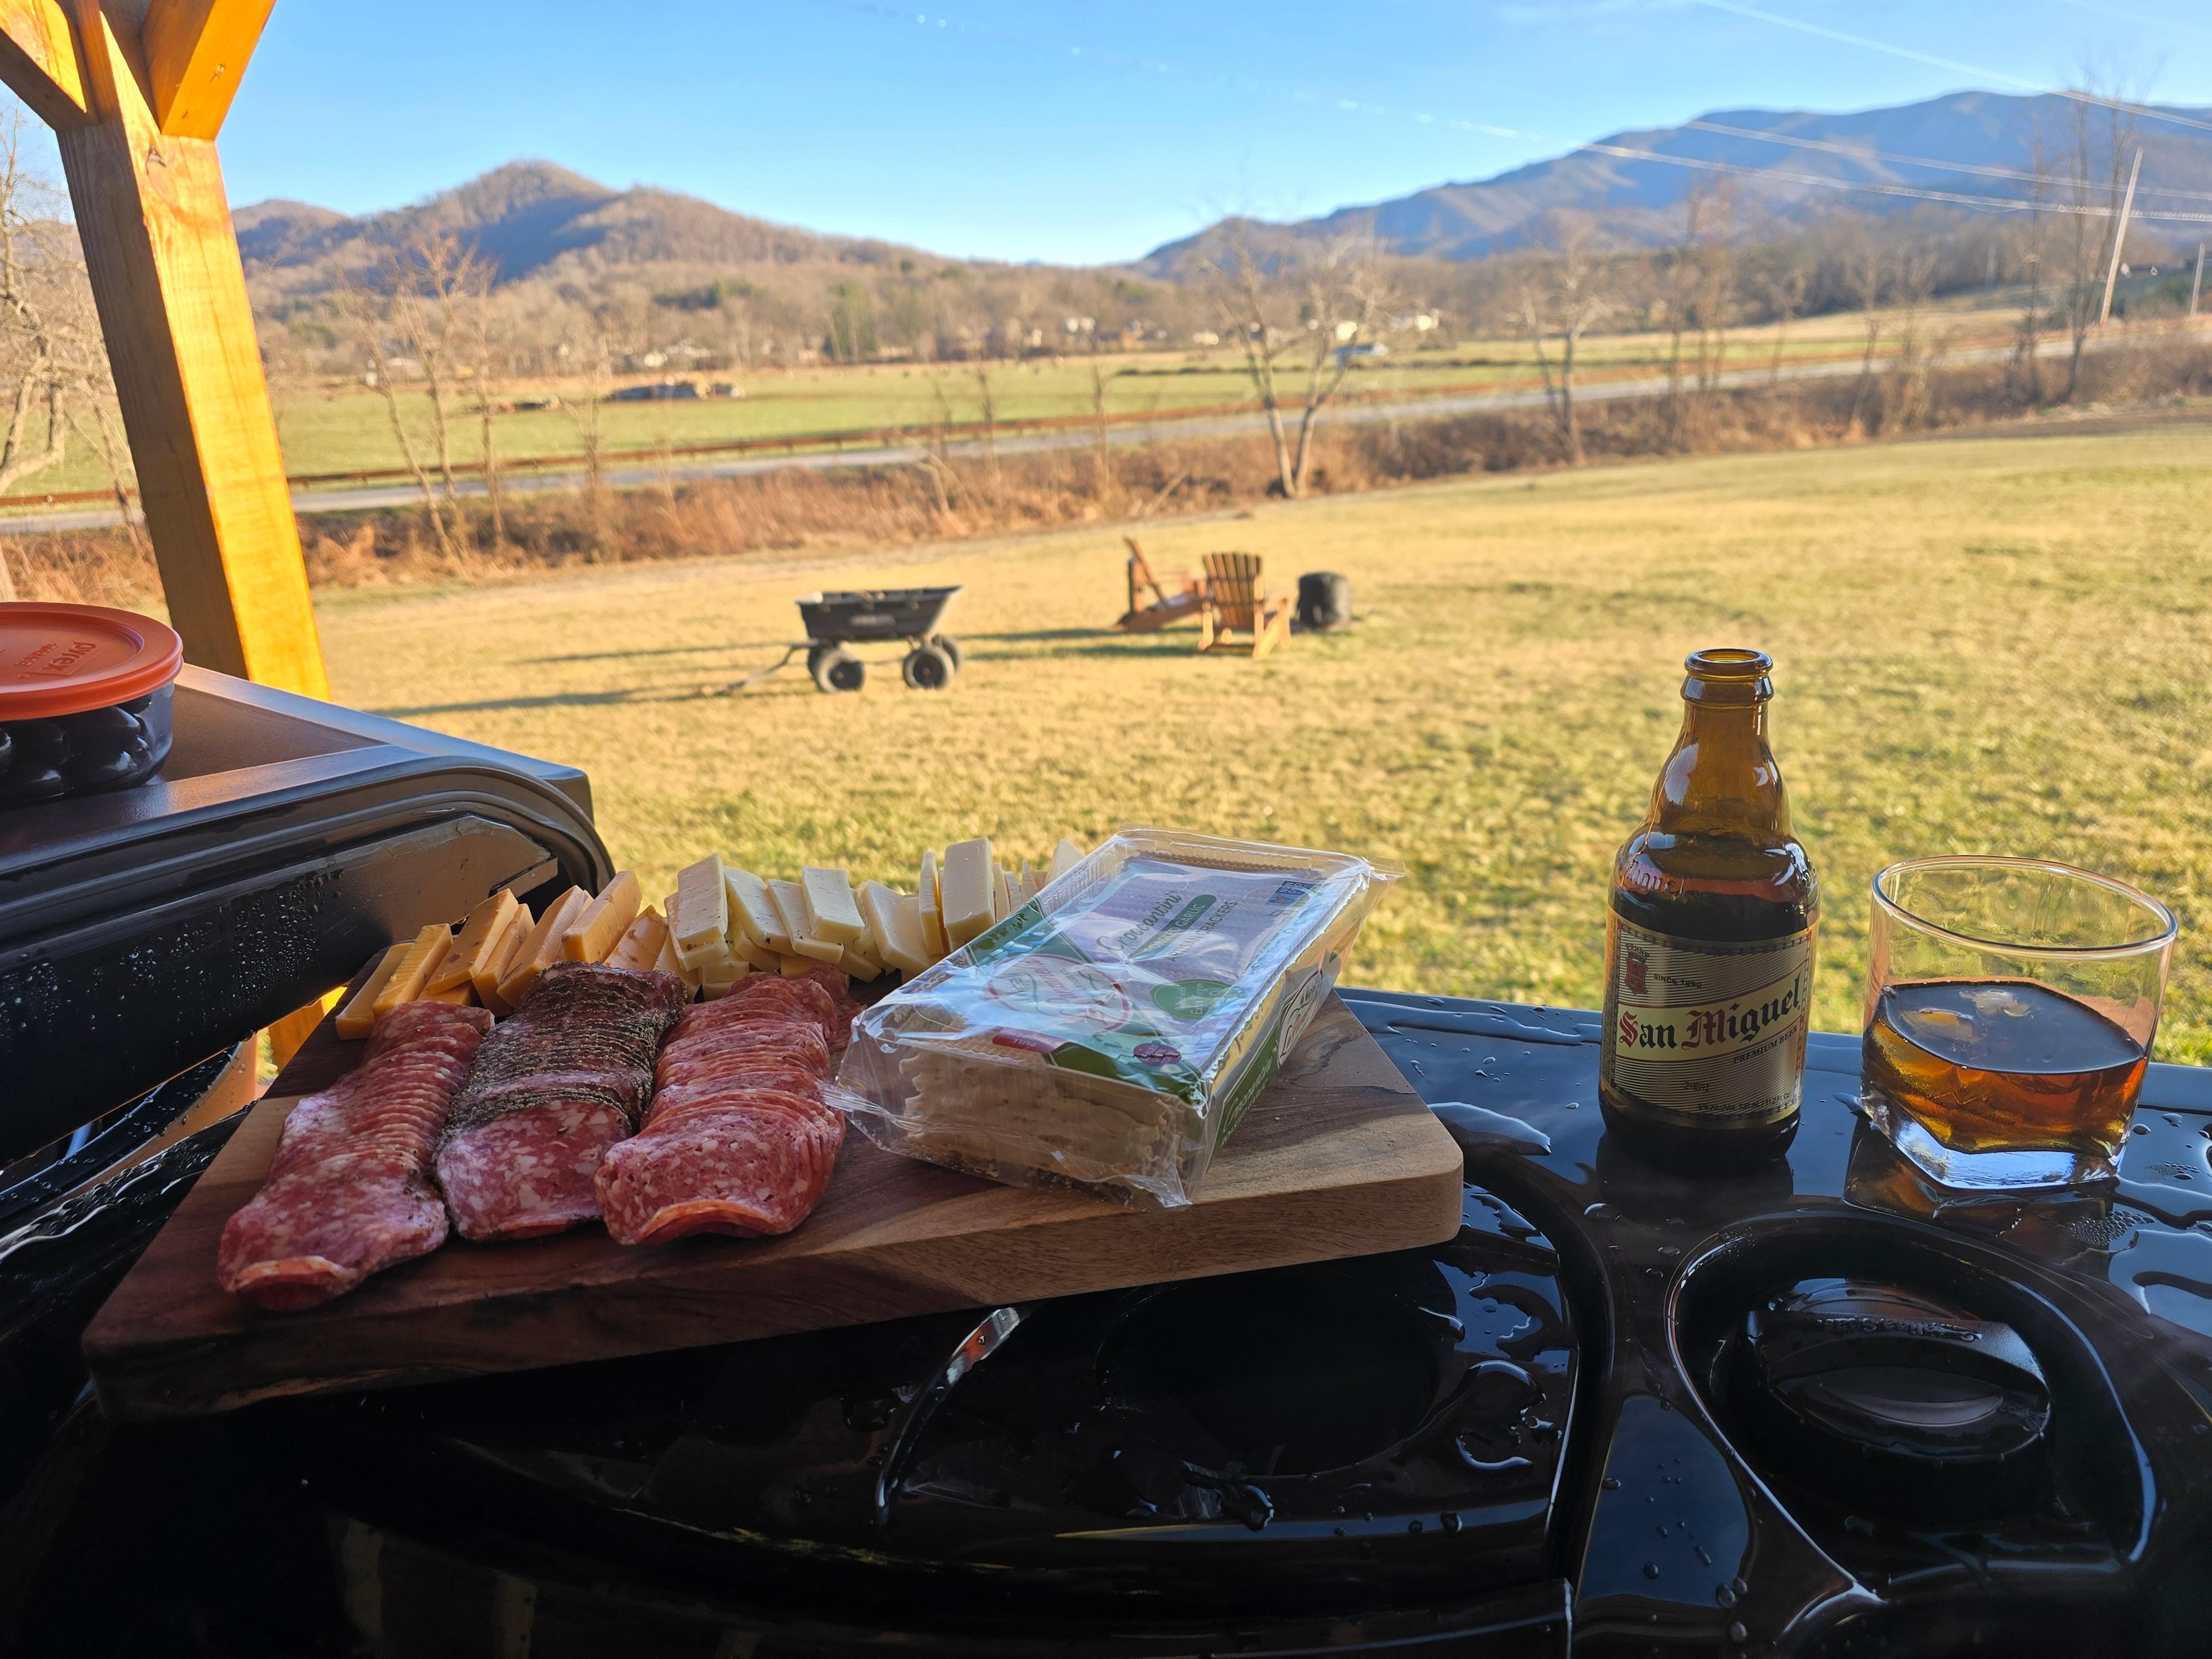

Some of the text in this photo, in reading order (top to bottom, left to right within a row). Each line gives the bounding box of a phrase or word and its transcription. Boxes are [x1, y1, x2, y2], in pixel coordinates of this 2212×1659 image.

[1095, 892, 1182, 951] Croccantini
[1144, 904, 1206, 952] ROASTED GARLIC
[1166, 901, 1238, 962] ARTISAN CRACKERS
[1653, 973, 1677, 985] SINCE
[1619, 1010, 1678, 1049] San
[1681, 972, 1801, 1050] Miguel
[1013, 1038, 1037, 1047] PULL
[1733, 1025, 1798, 1064] PREMIUM BEER
